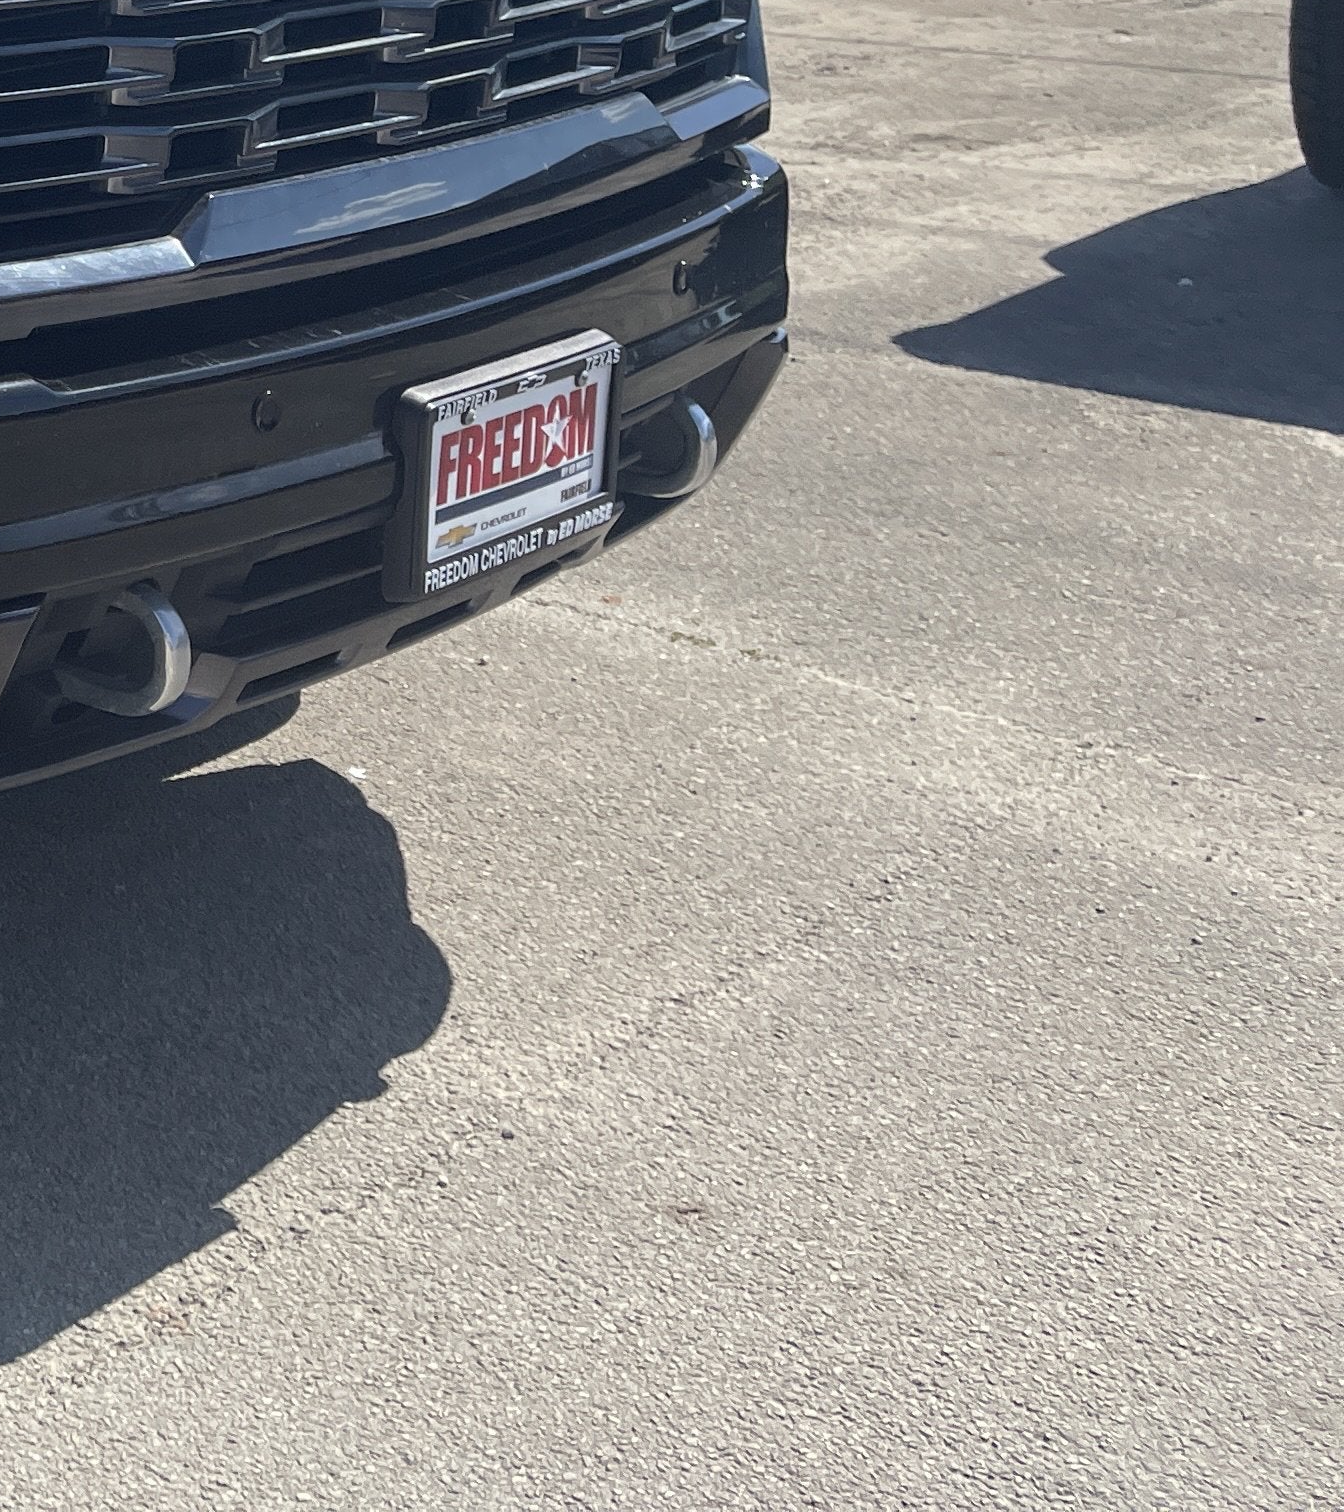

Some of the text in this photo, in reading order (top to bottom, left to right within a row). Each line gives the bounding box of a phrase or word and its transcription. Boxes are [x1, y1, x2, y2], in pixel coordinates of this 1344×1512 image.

[437, 347, 621, 421] FAIRFIELD TEXAS
[436, 382, 599, 506] FREEDOM
[424, 553, 479, 594] FREEDOM
[480, 527, 544, 572] CHEVROLET
[558, 519, 574, 541] ED
[574, 502, 614, 534] MORSE
[480, 506, 528, 531] CHEVROLET
